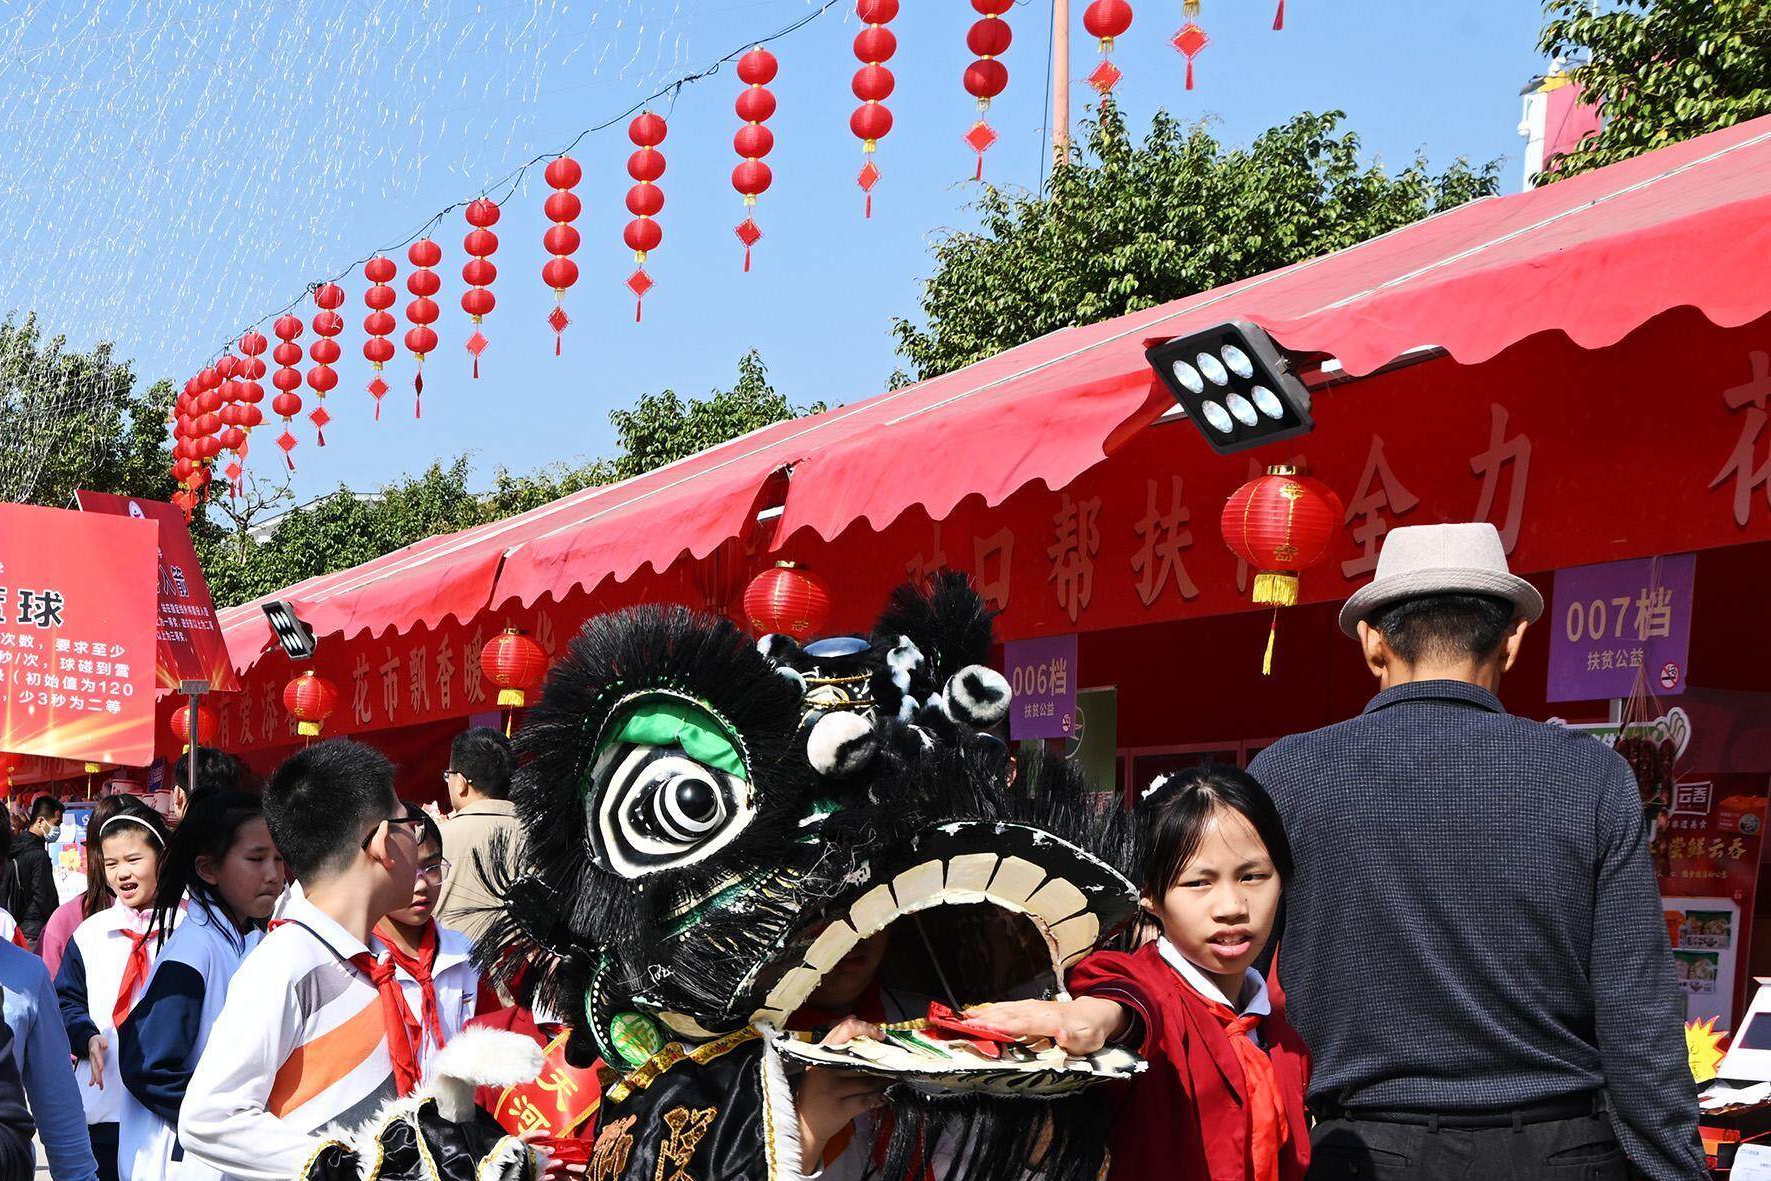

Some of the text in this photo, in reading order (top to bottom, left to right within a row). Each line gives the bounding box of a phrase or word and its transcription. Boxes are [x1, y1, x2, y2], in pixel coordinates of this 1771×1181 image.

[1566, 586, 1673, 642] 007档
[1587, 647, 1645, 671] 扶贫公益
[1012, 656, 1067, 697] 006档
[1024, 701, 1055, 718] 扶贫公益
